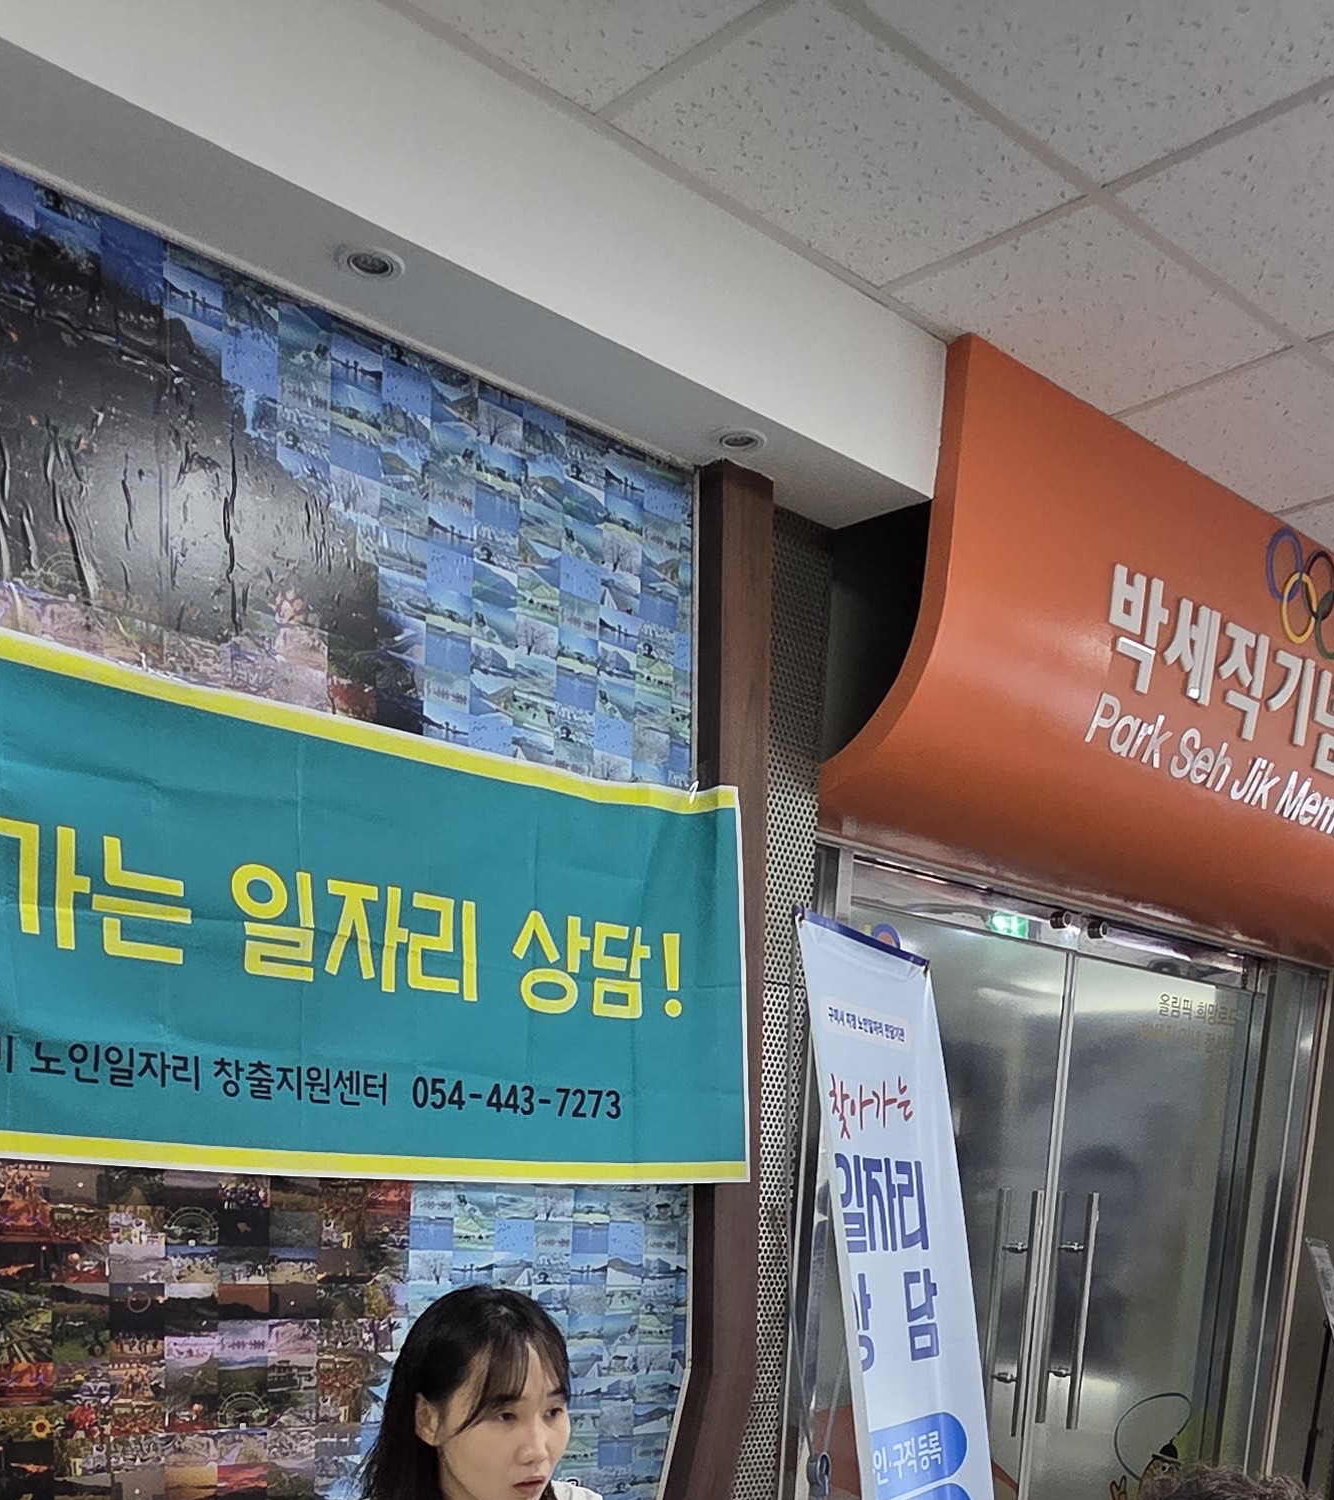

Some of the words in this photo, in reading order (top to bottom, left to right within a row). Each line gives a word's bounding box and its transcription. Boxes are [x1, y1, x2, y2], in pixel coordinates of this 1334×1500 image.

[1084, 692, 1167, 768] Park
[1167, 726, 1233, 793] Seh
[1233, 757, 1278, 809] Jik
[231, 863, 479, 1002] 일자리
[511, 909, 682, 1020] 상담!
[29, 1039, 201, 1094] 노인일자리
[214, 1058, 389, 1109] 창출지원센터
[412, 1075, 623, 1121] 054-443-7273
[827, 1074, 915, 1142] 찾아가는
[834, 1152, 930, 1256] 일자리
[871, 1437, 918, 1486] 인·구직
[918, 1430, 942, 1470] 등록
